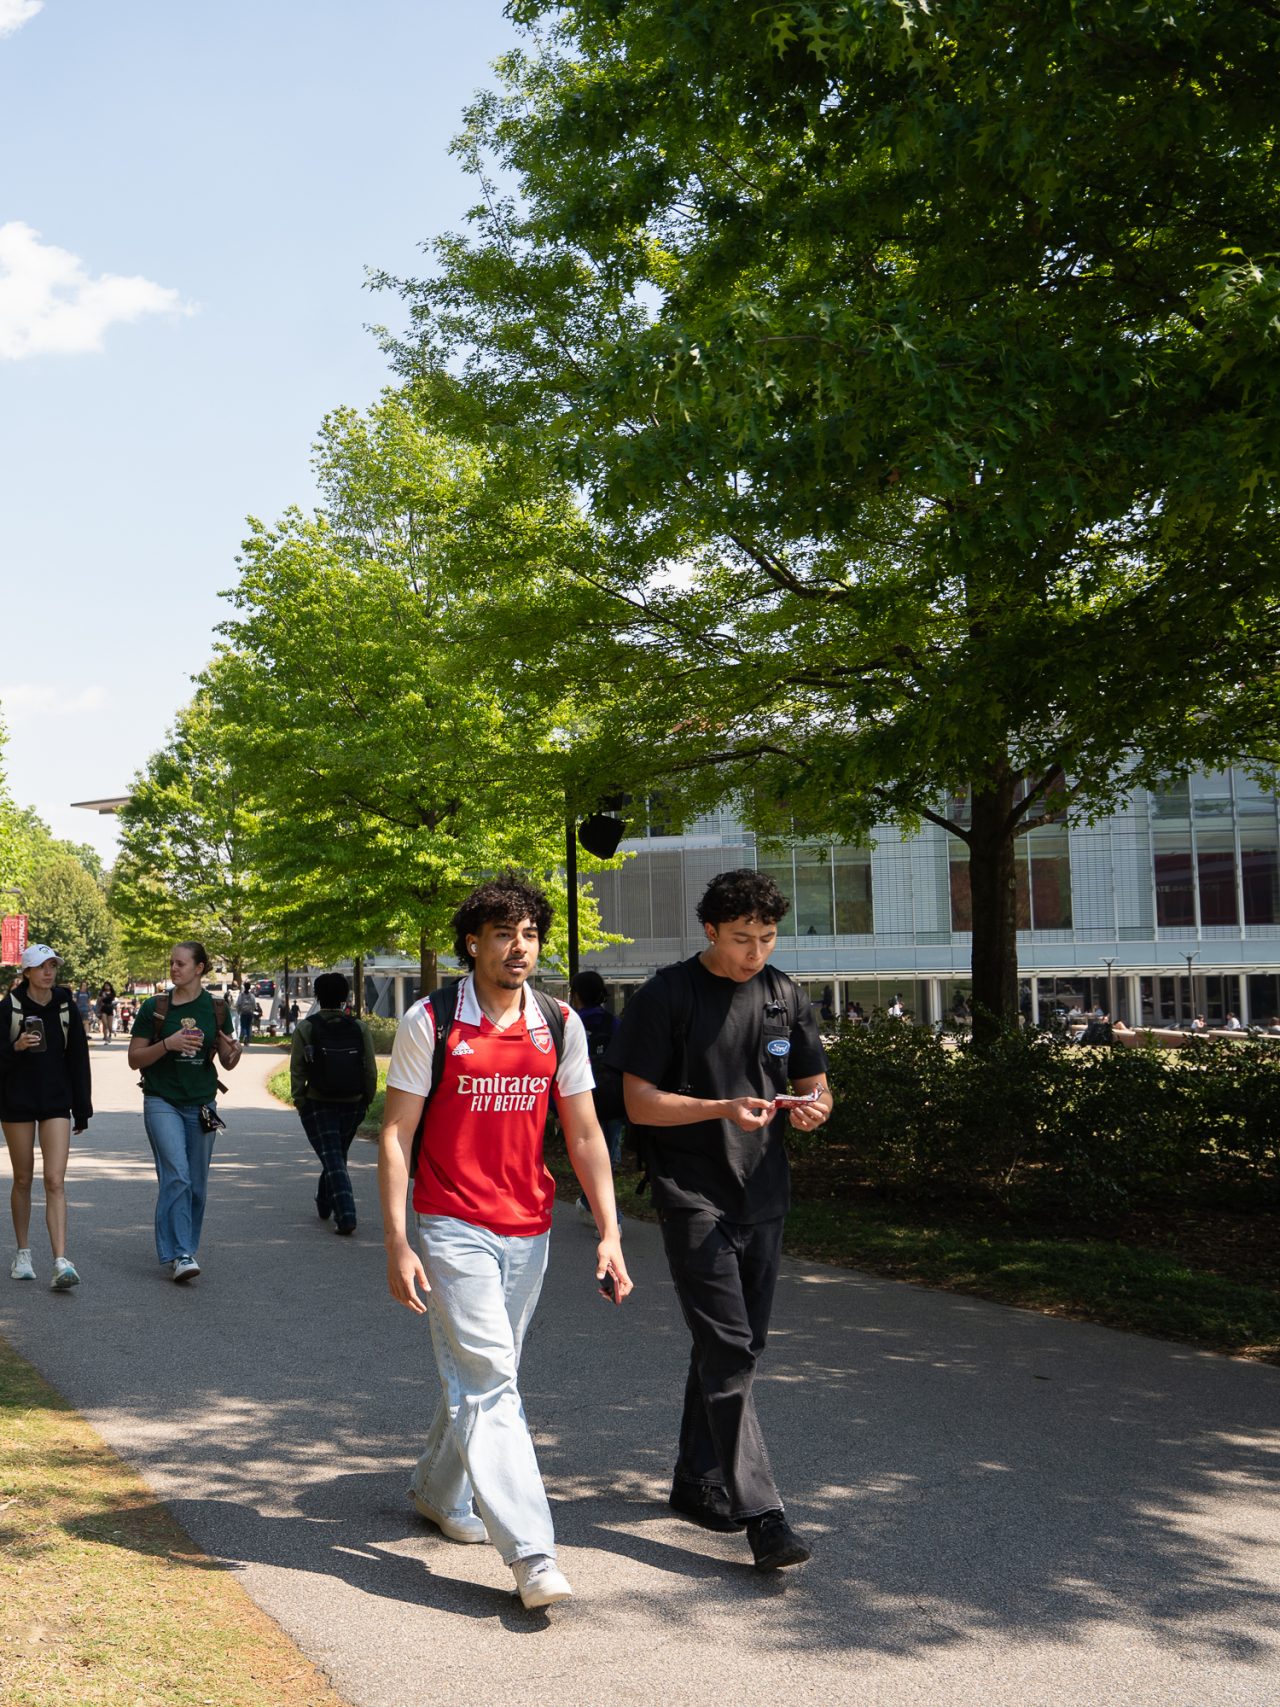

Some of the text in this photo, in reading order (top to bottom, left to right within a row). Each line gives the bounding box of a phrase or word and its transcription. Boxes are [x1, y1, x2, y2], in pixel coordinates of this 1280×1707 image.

[457, 1072, 550, 1095] Emirates
[470, 1094, 536, 1112] FLY BETTER
